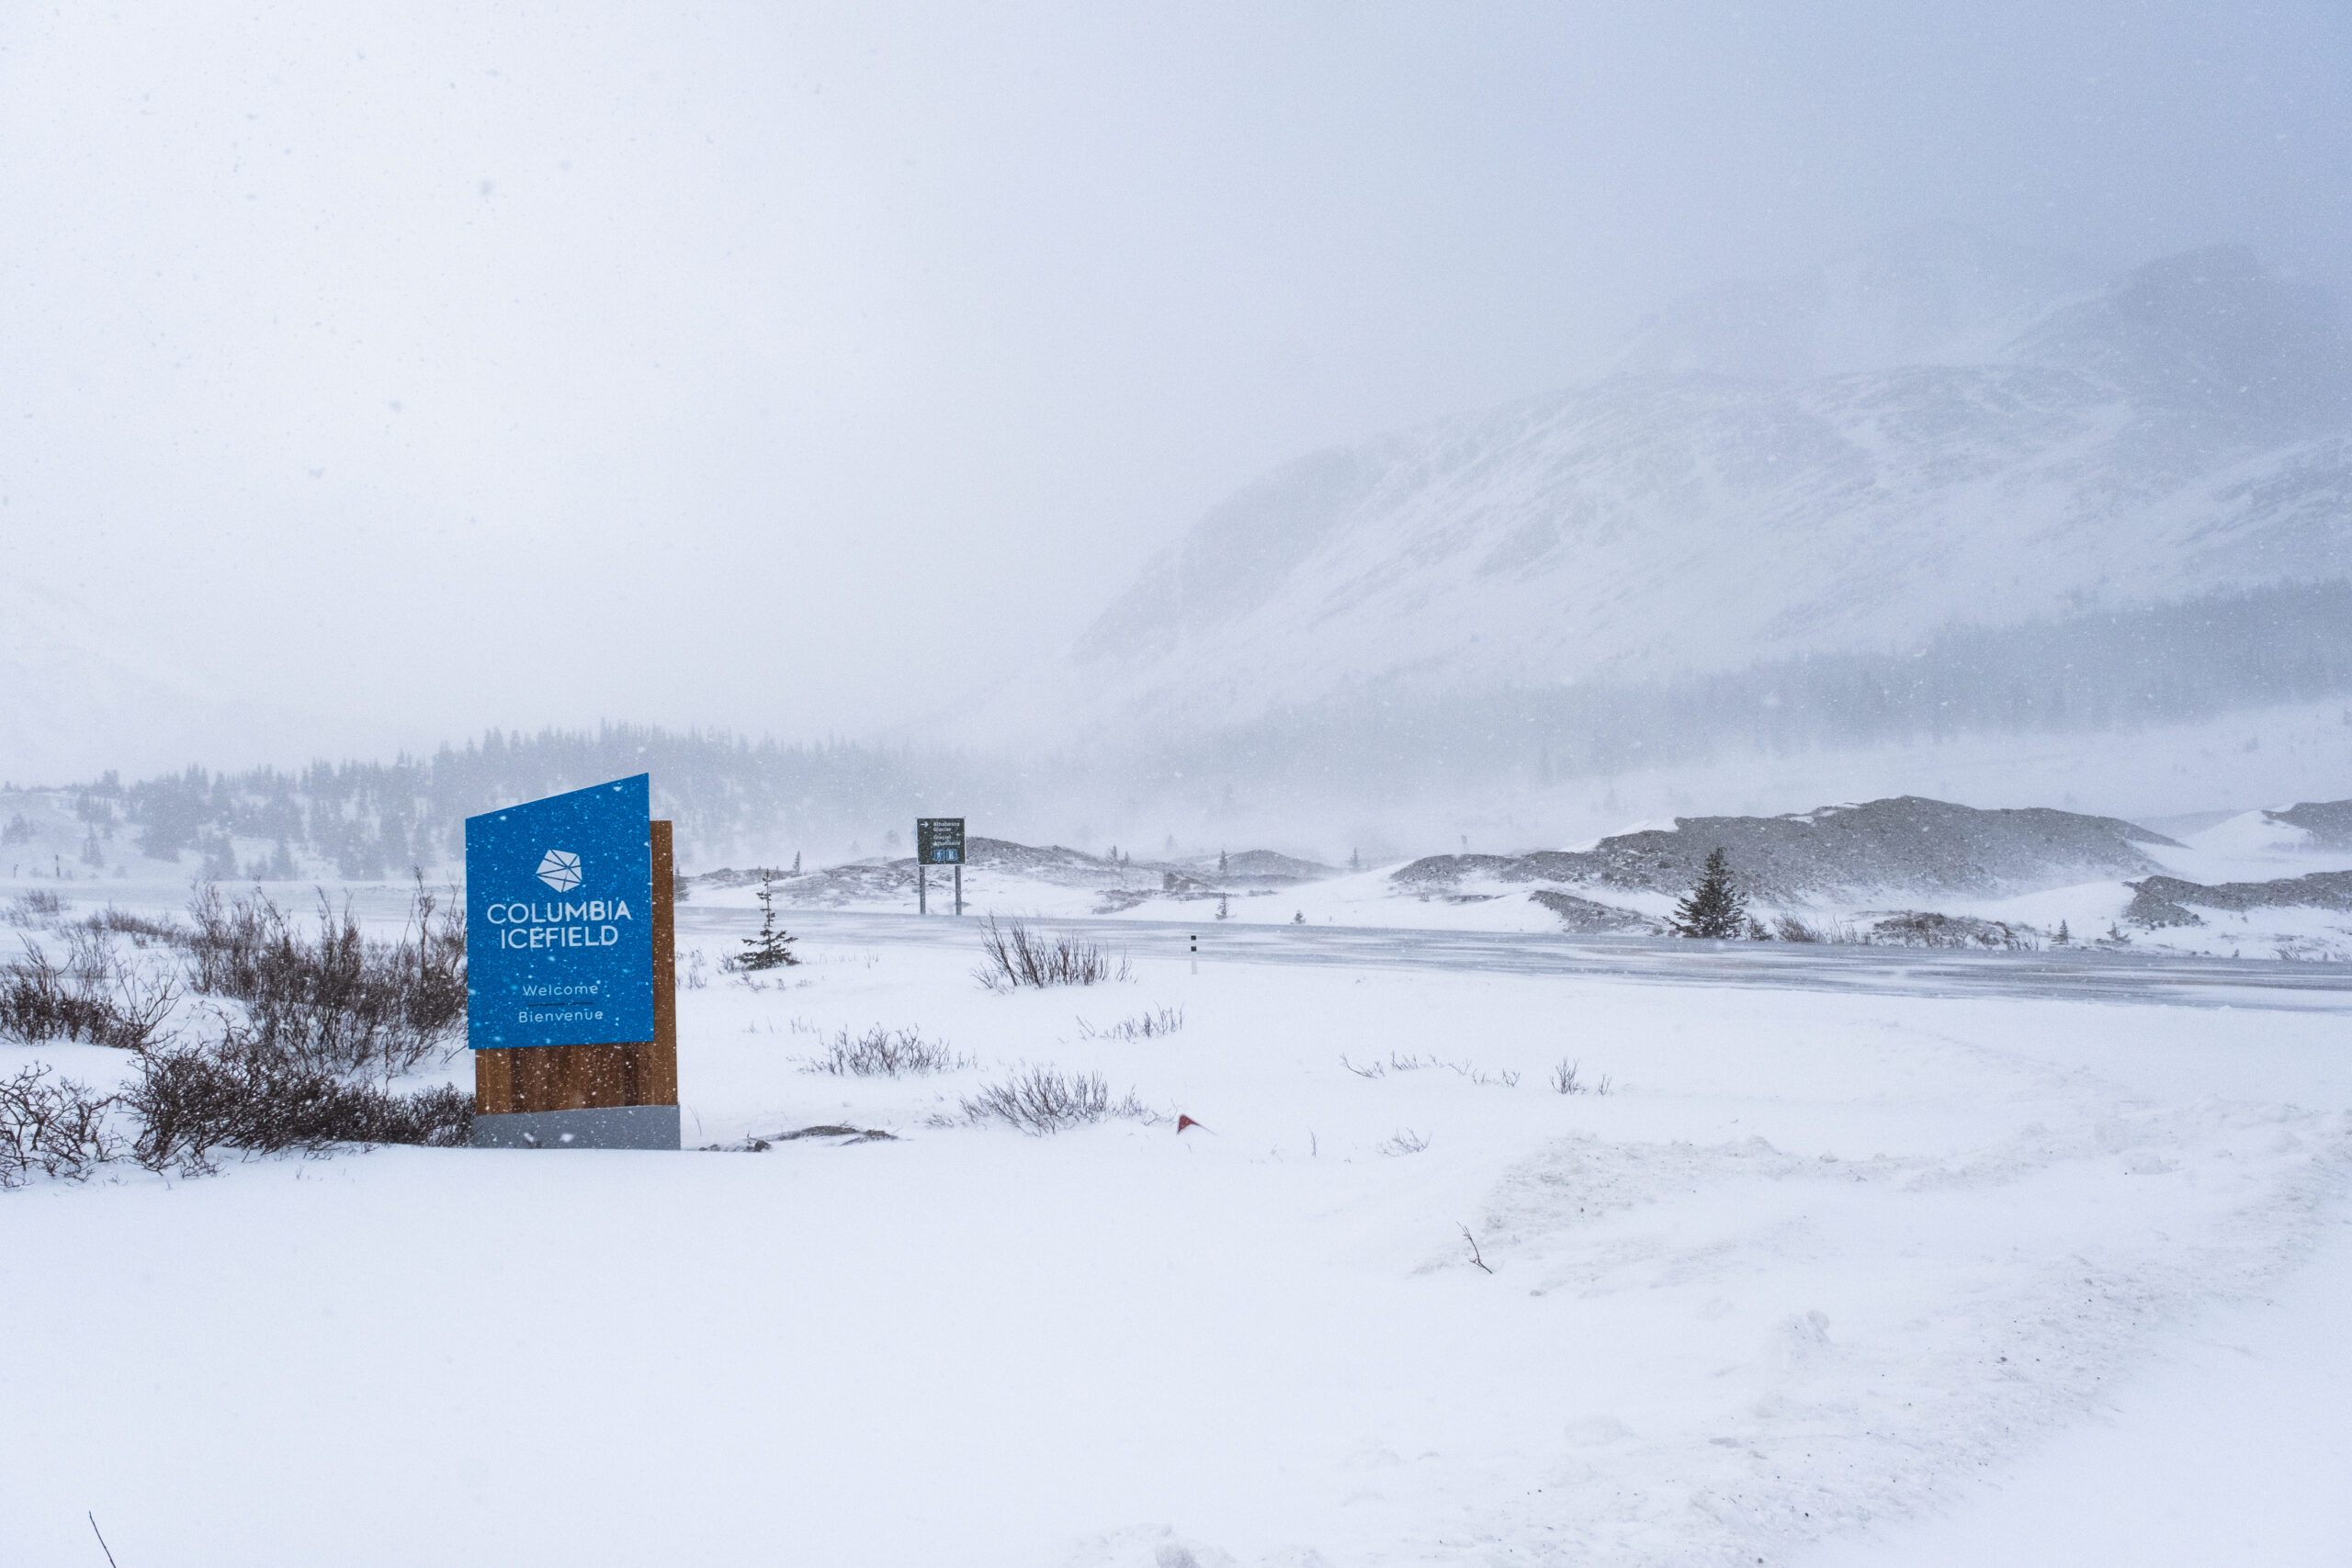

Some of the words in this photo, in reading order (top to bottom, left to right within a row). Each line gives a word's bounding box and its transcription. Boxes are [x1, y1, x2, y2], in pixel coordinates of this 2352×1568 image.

[487, 900, 631, 924] COLUMBIA
[501, 925, 618, 949] ICEFIELD
[523, 984, 598, 997] Welcome
[518, 1010, 604, 1023] Bienvenue
